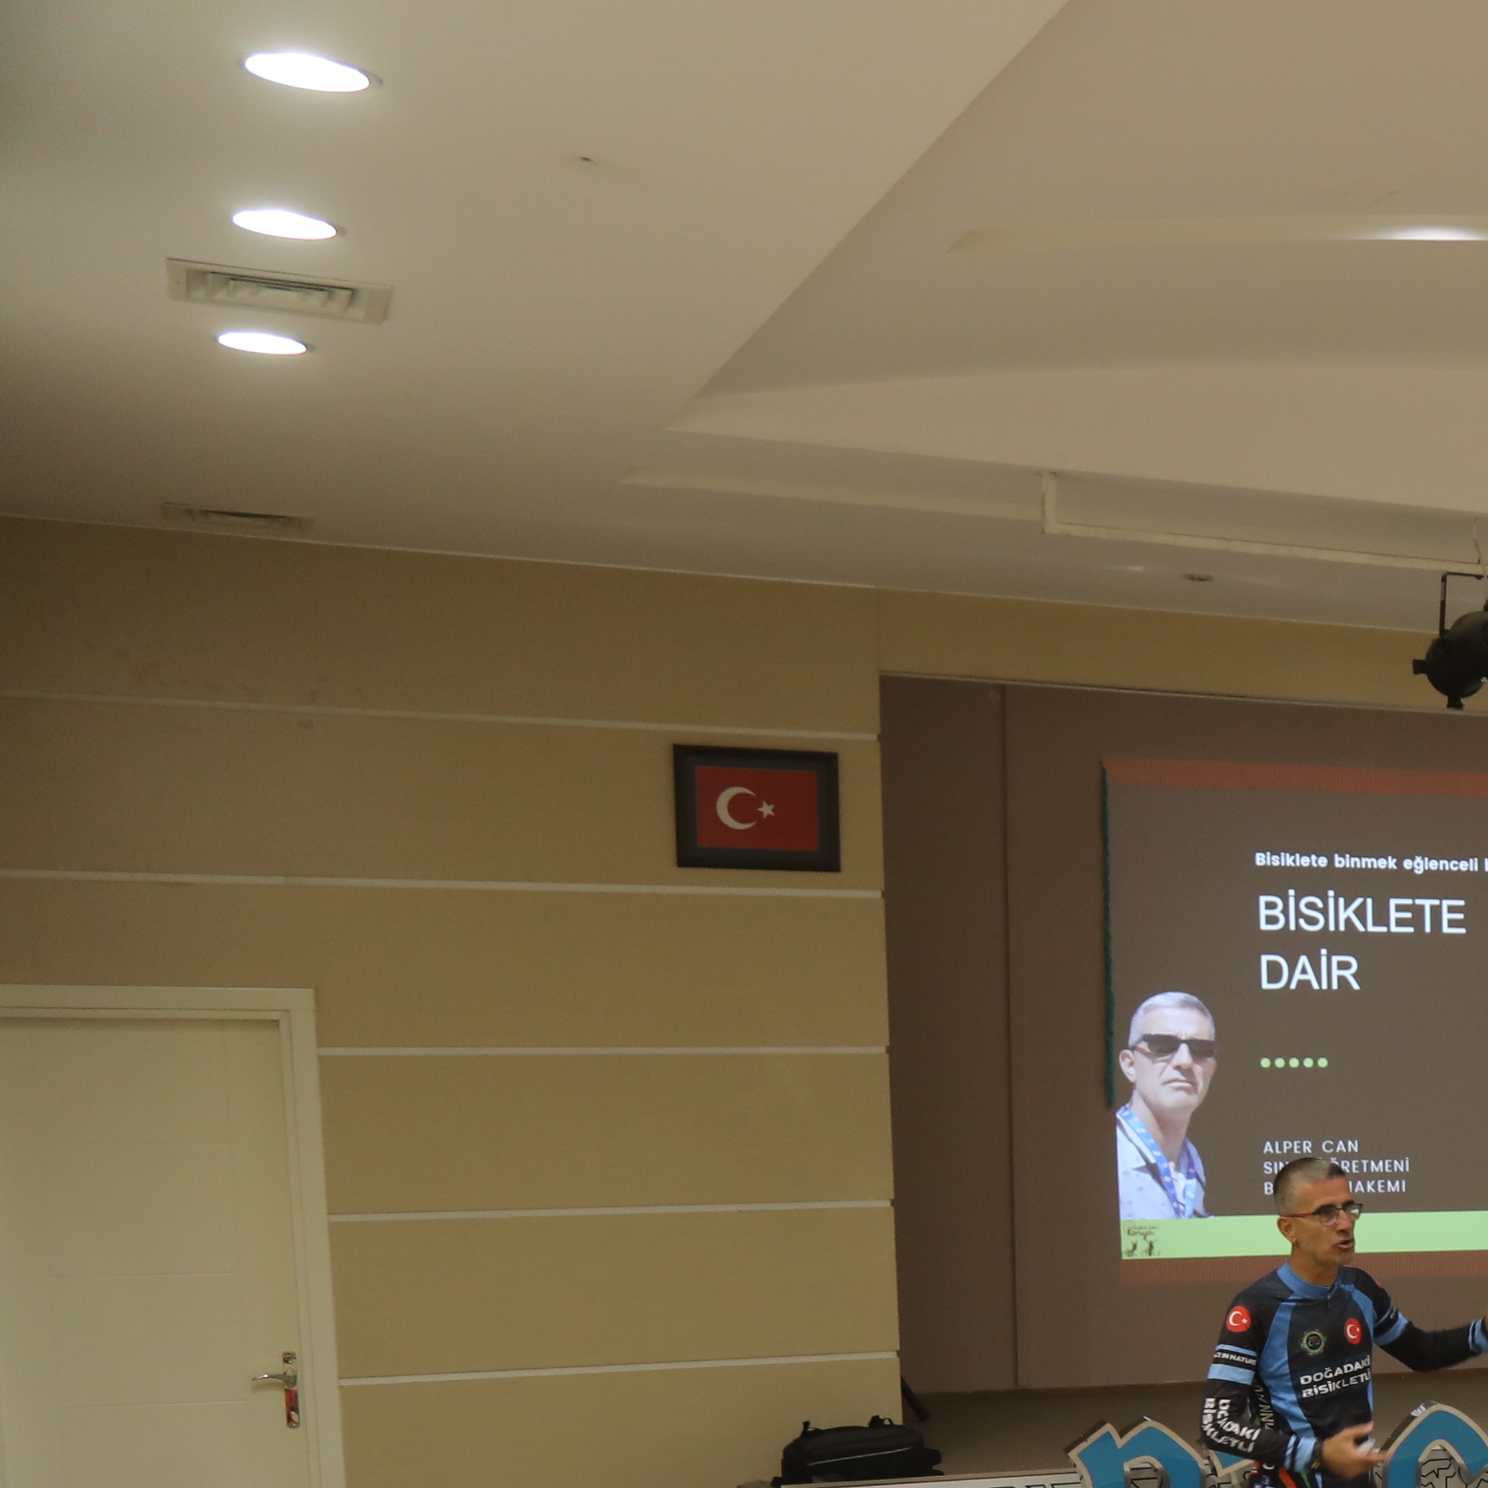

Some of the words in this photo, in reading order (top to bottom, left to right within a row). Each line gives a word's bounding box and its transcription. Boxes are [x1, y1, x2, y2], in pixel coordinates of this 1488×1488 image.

[1254, 852, 1328, 868] Bisiklete
[1334, 853, 1398, 870] binmek
[1403, 856, 1479, 875] eğlenceli
[1258, 888, 1467, 934] BİSİKLETE
[1260, 948, 1361, 991] DAİR
[1263, 1140, 1313, 1154] ALPER
[1321, 1139, 1359, 1153] CAN
